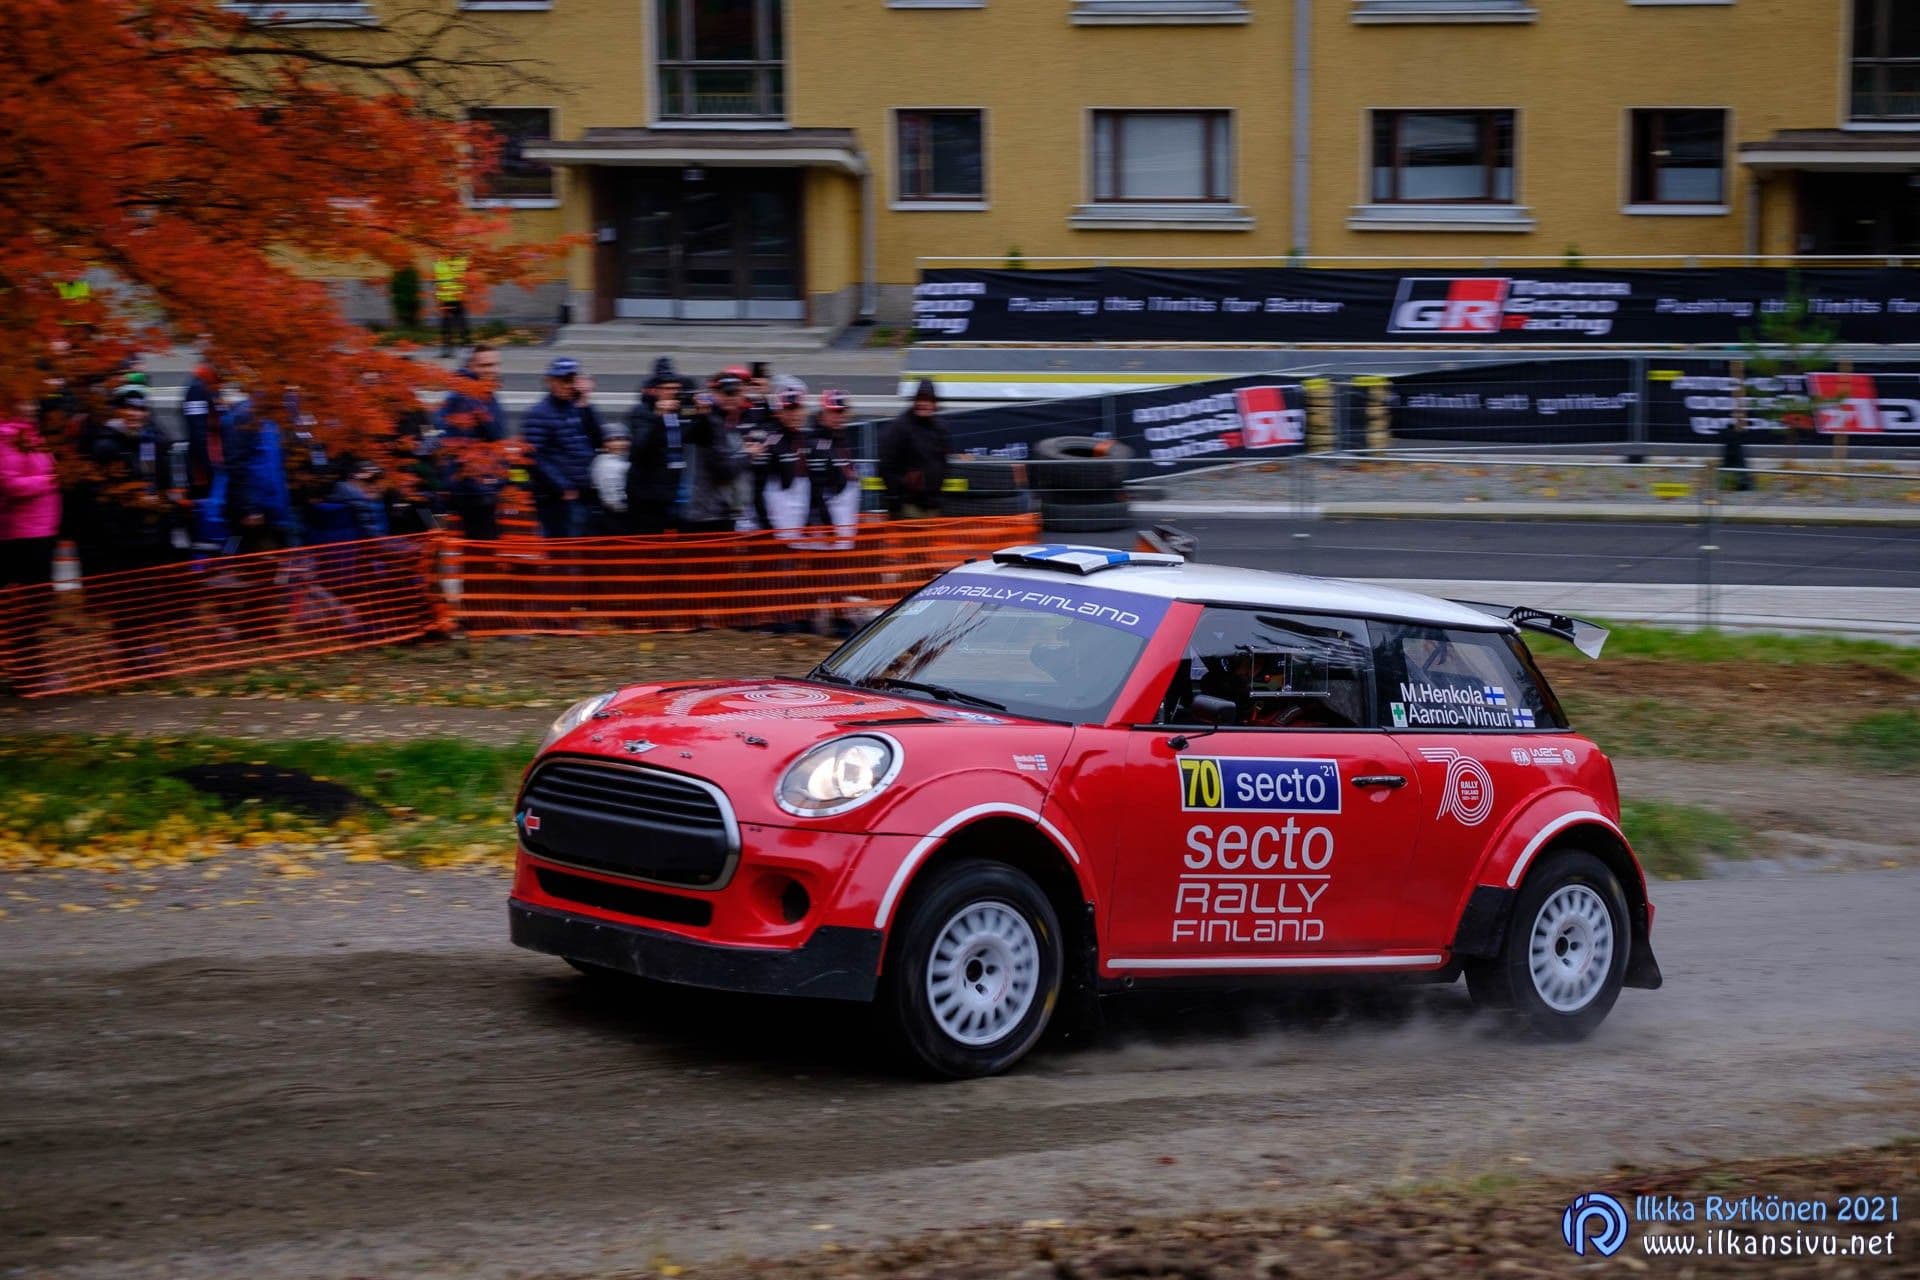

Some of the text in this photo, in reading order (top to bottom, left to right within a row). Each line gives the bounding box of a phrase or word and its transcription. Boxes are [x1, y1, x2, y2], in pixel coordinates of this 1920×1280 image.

[1103, 296, 1145, 311] the
[952, 585, 1024, 600] RALLY
[1020, 591, 1140, 627] FINLAND
[1400, 682, 1485, 705] M.Henkola
[1409, 703, 1512, 728] Aarnio-Wihuri
[1180, 760, 1223, 807] 70
[1236, 768, 1326, 803] secto
[1183, 816, 1334, 870] secto
[1175, 882, 1329, 914] RALLY
[1172, 919, 1324, 943] FINLAND
